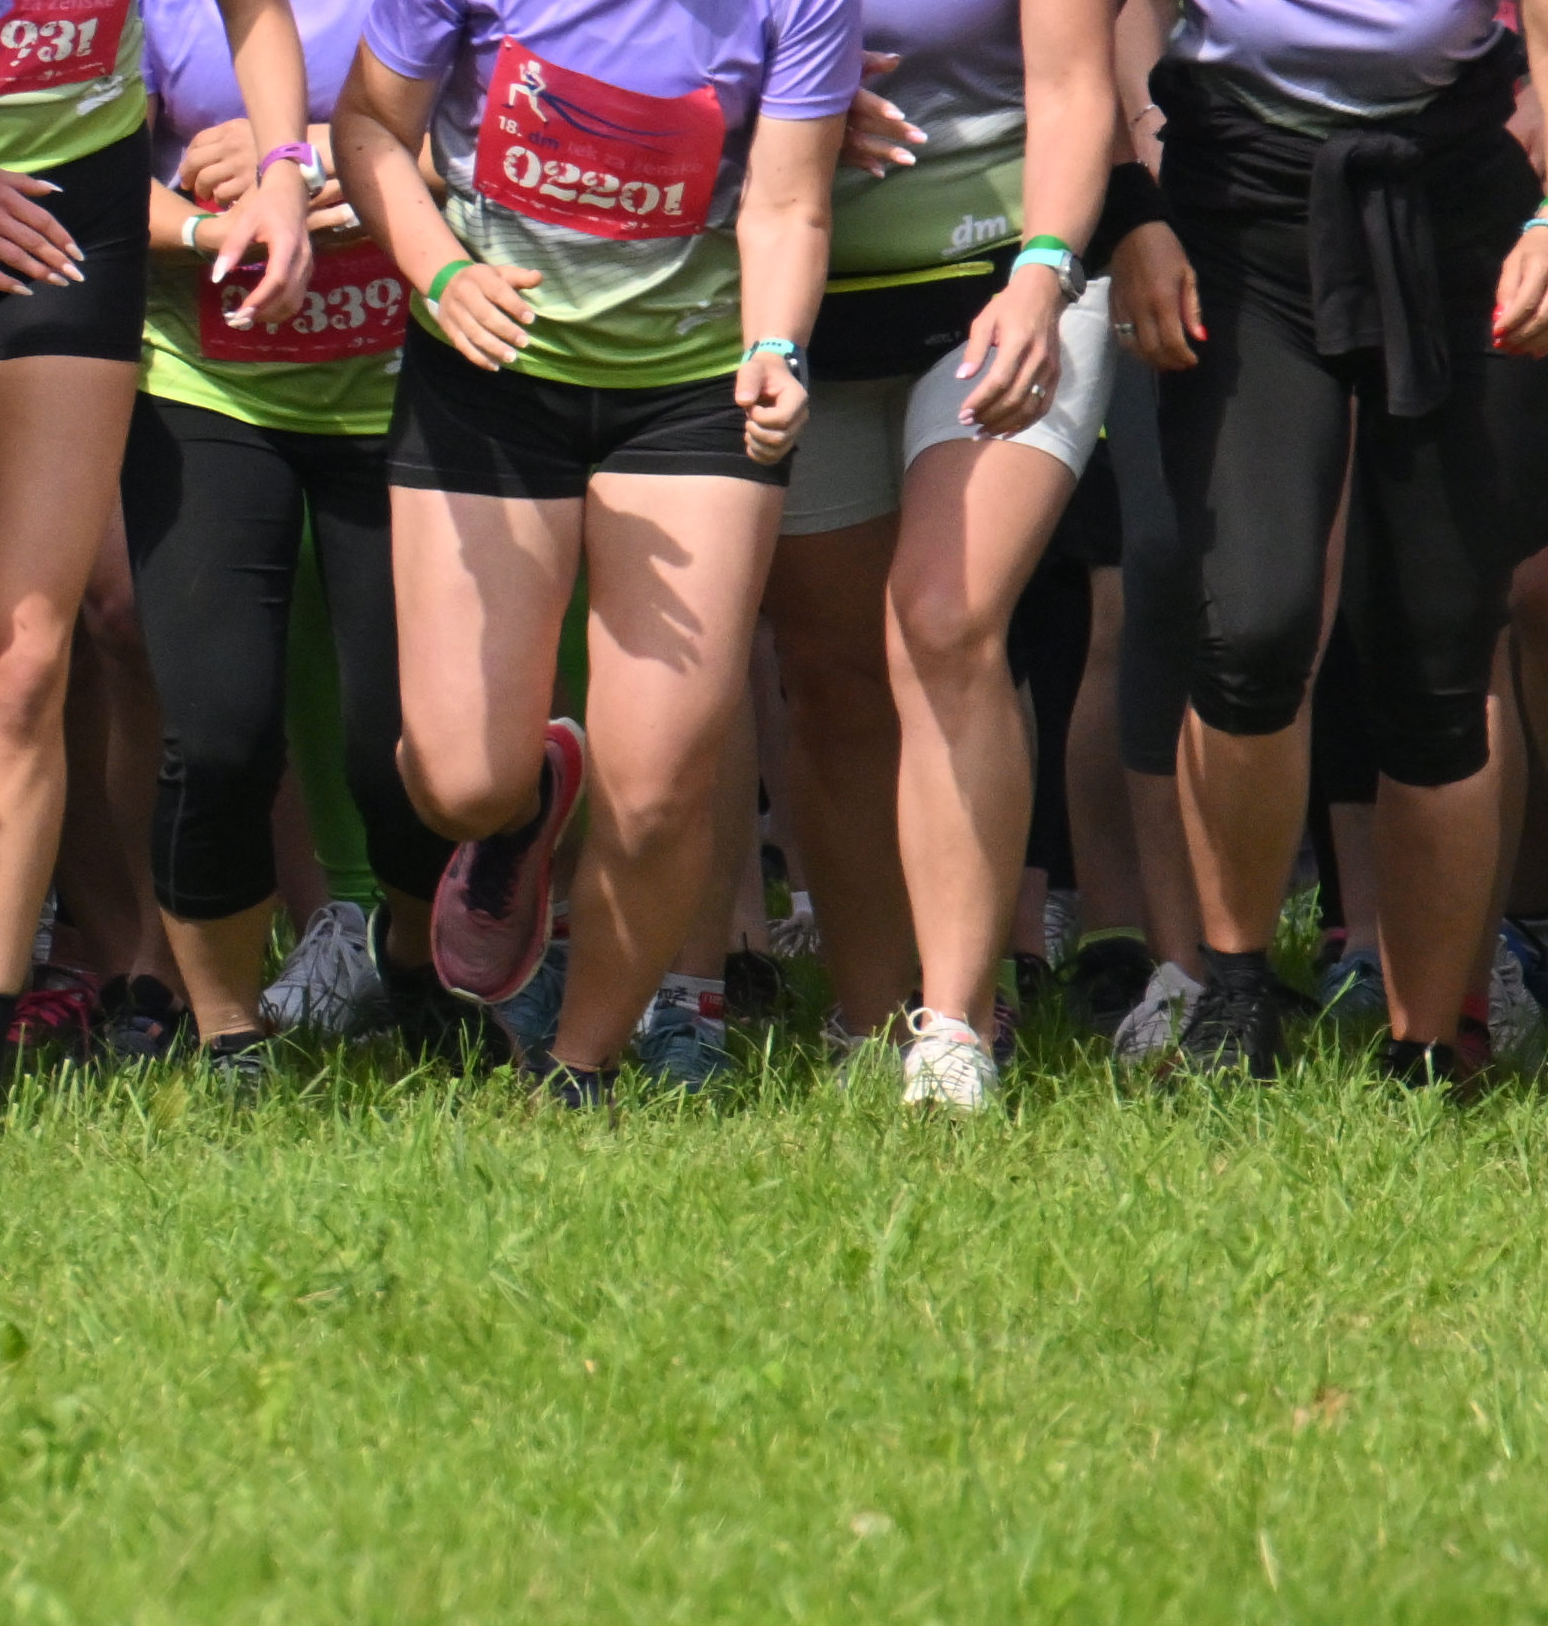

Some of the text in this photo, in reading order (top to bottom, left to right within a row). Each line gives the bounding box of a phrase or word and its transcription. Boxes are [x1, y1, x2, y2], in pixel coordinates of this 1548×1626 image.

[498, 115, 523, 137] 18.
[528, 131, 560, 150] dm
[503, 145, 685, 215] 02201
[952, 215, 1007, 247] dm
[221, 278, 402, 334] 0339
